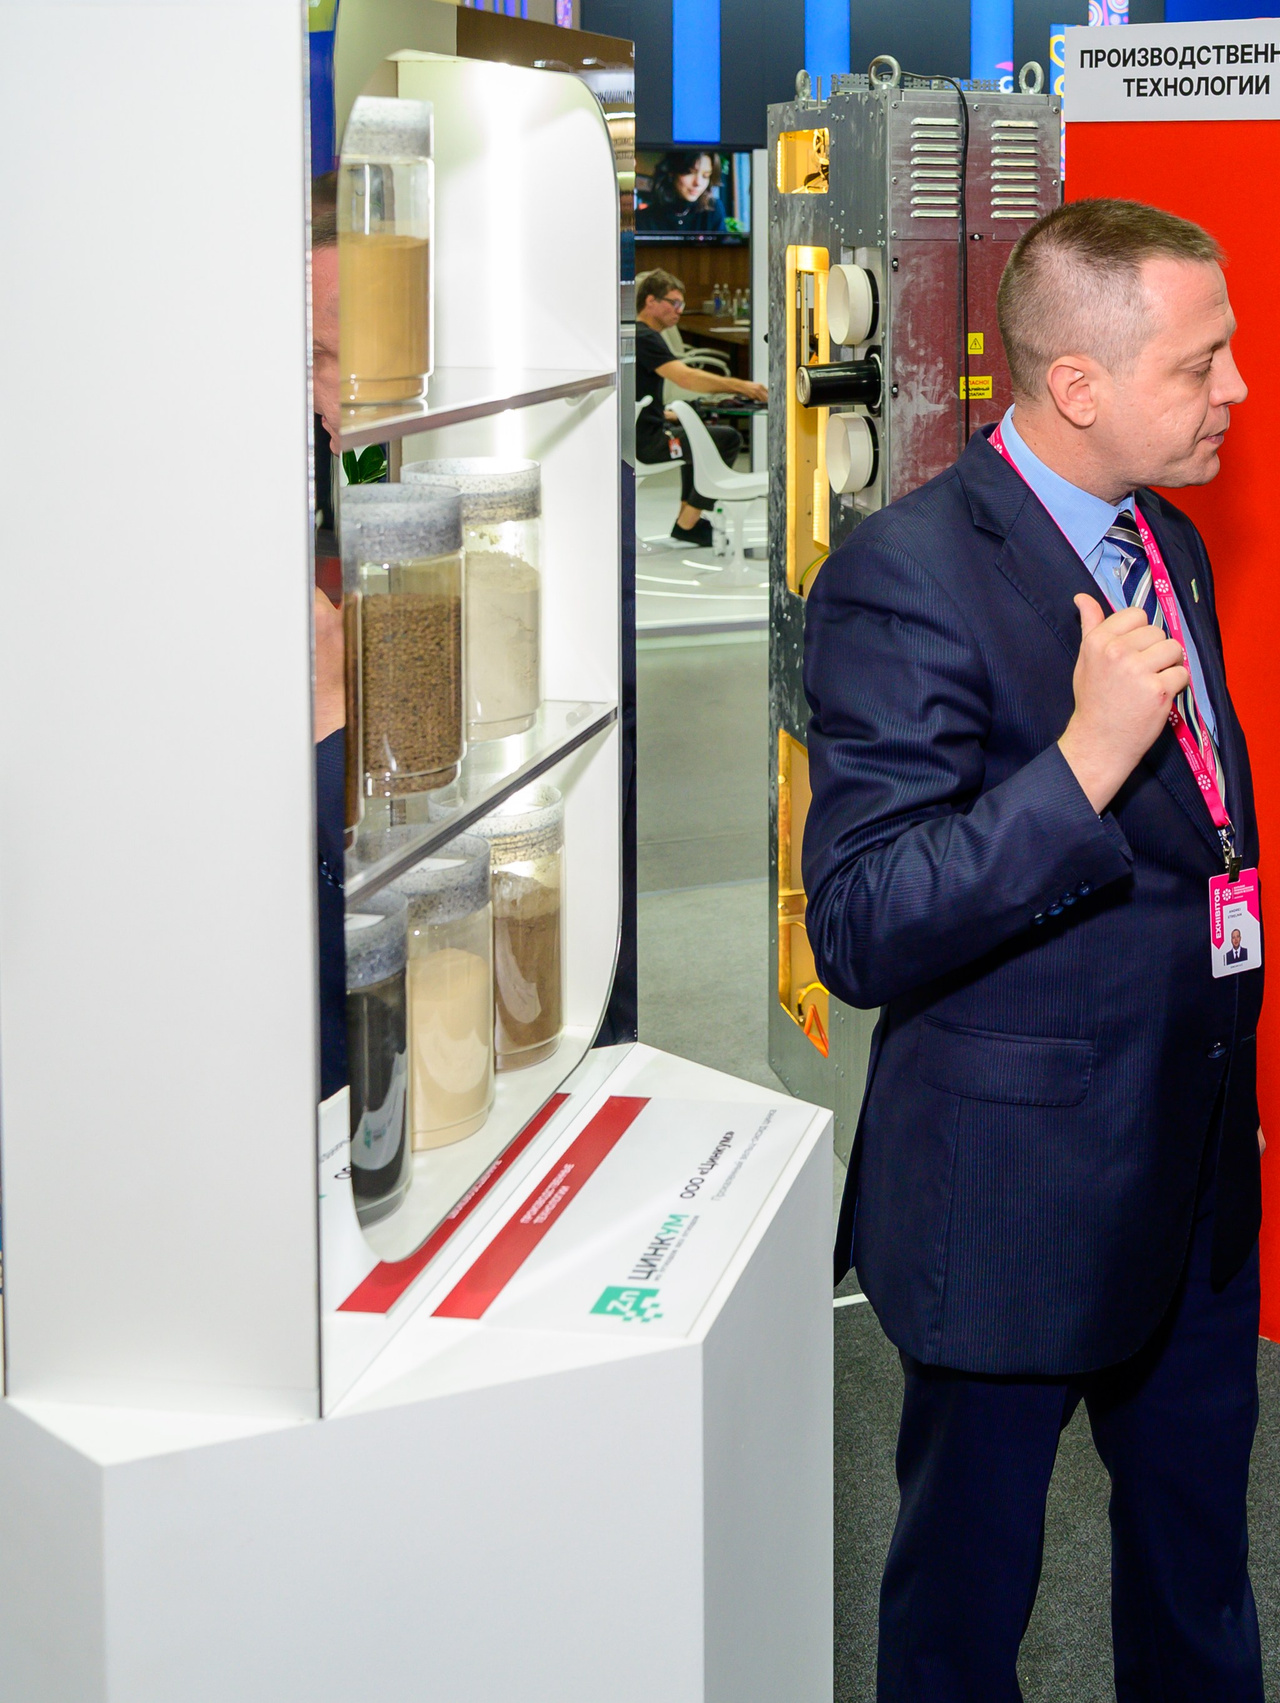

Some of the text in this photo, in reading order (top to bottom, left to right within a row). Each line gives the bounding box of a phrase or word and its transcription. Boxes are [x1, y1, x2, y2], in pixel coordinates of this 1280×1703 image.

[1123, 75, 1270, 97] ТЕХНОЛОГИИ
[1213, 888, 1221, 939] EXHIBITOR
[679, 1130, 735, 1199] ООО «Цинкум»
[627, 1213, 690, 1281] ЦИНКУМ
[604, 1289, 641, 1312] Zn
